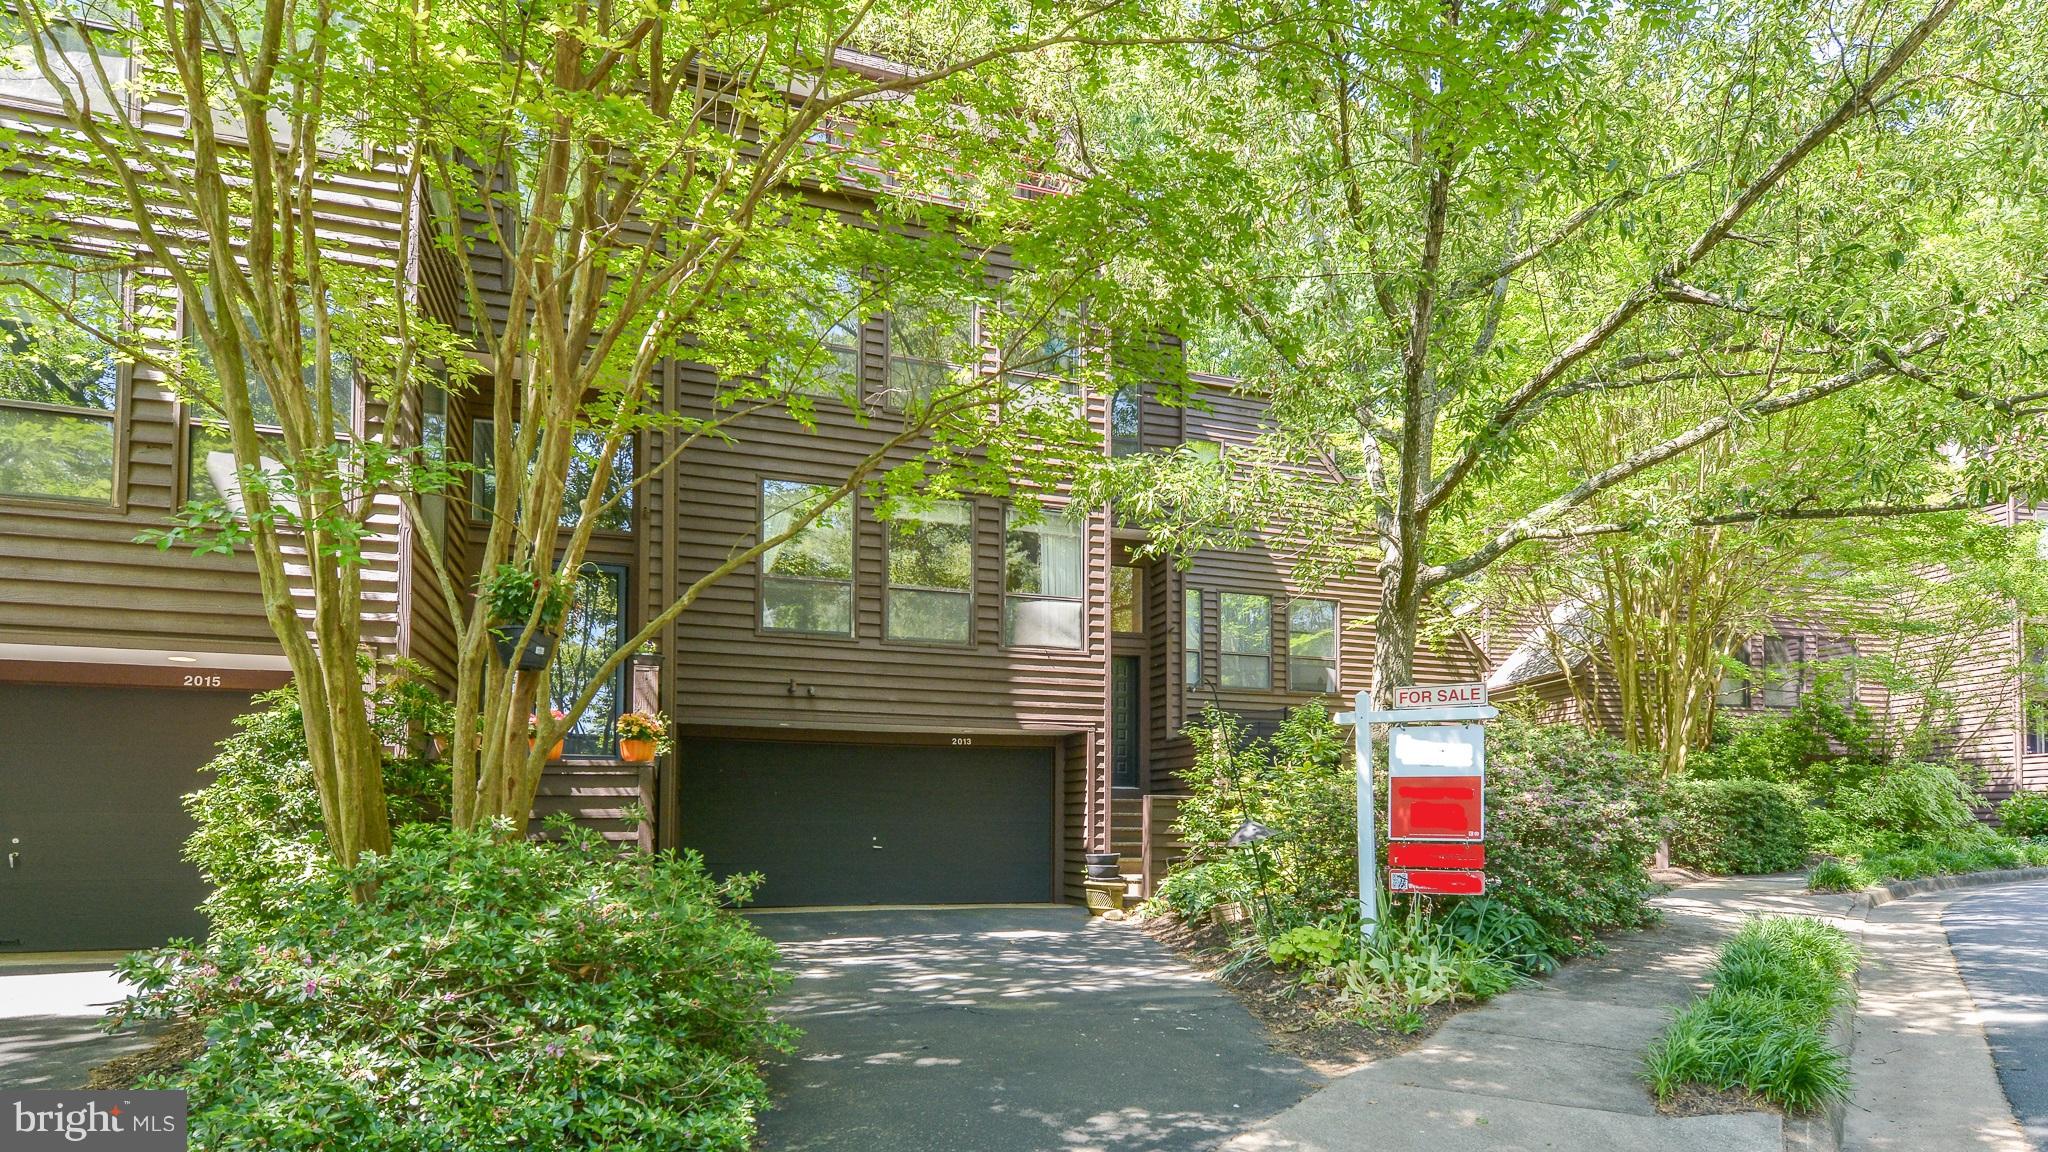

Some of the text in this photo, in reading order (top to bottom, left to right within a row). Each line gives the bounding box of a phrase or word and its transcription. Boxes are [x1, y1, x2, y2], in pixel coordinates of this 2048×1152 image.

[183, 675, 221, 687] 2015
[1399, 688, 1481, 704] FOR SALE
